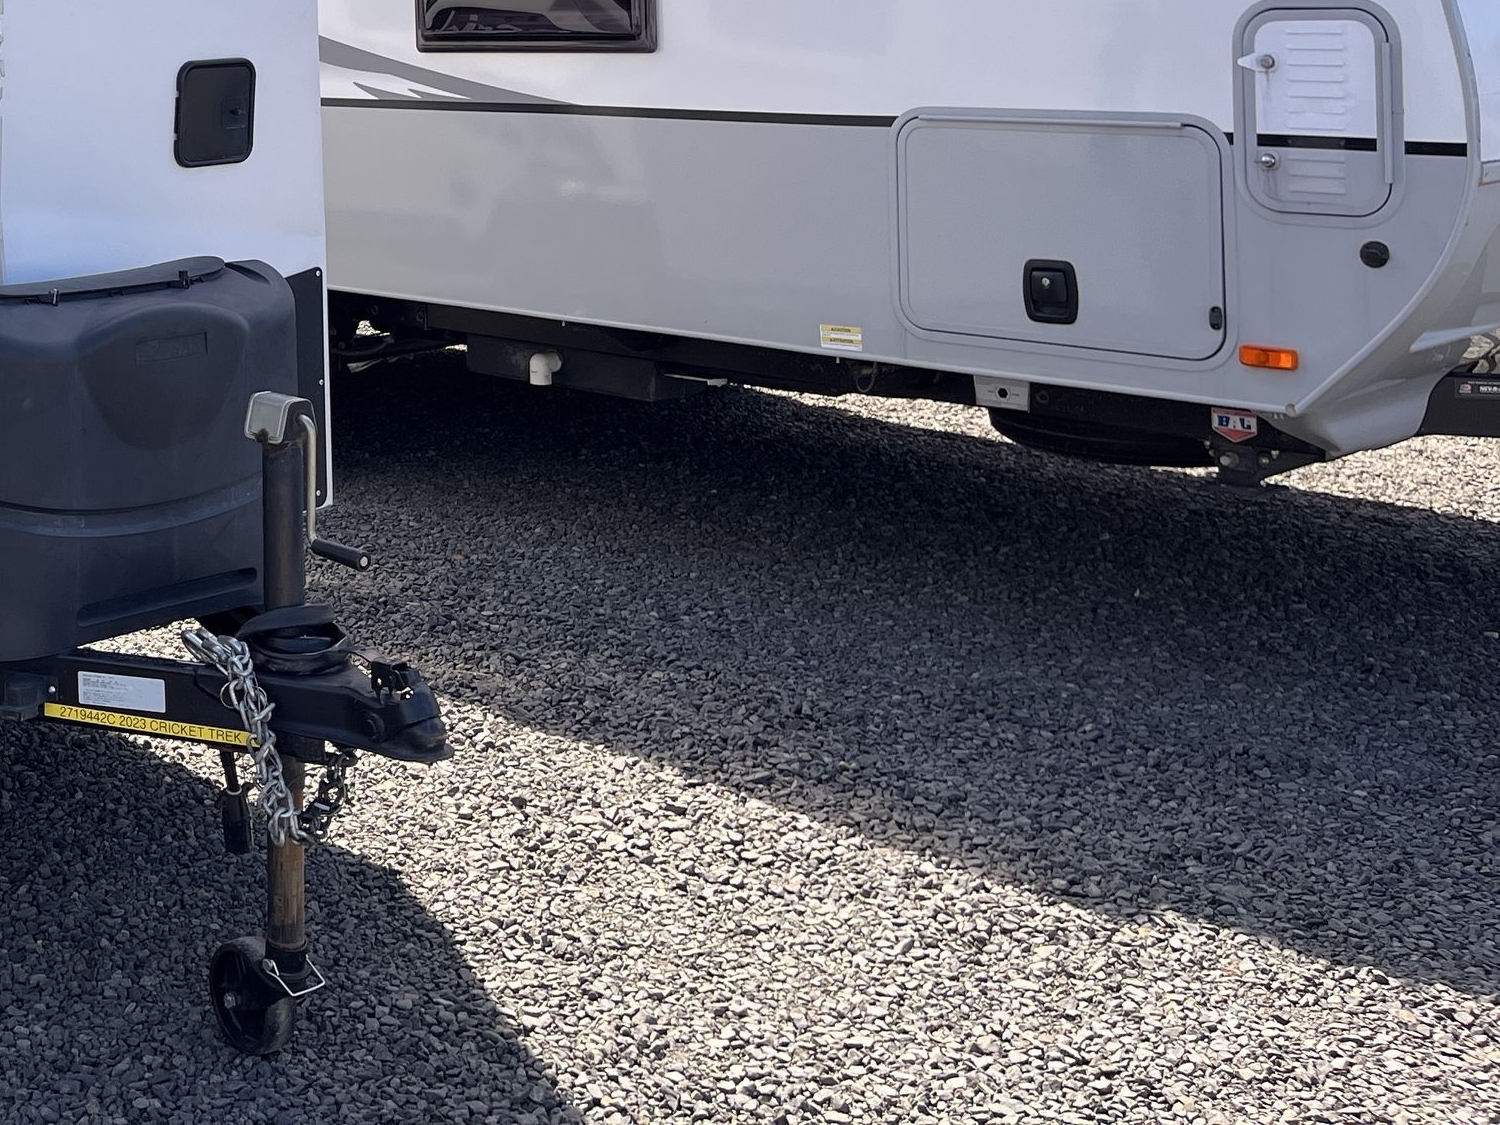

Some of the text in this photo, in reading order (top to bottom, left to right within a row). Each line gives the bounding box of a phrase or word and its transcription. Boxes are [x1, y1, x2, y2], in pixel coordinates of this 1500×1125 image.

[59, 706, 242, 743] 2719442C 2023 CRICKET TREK
